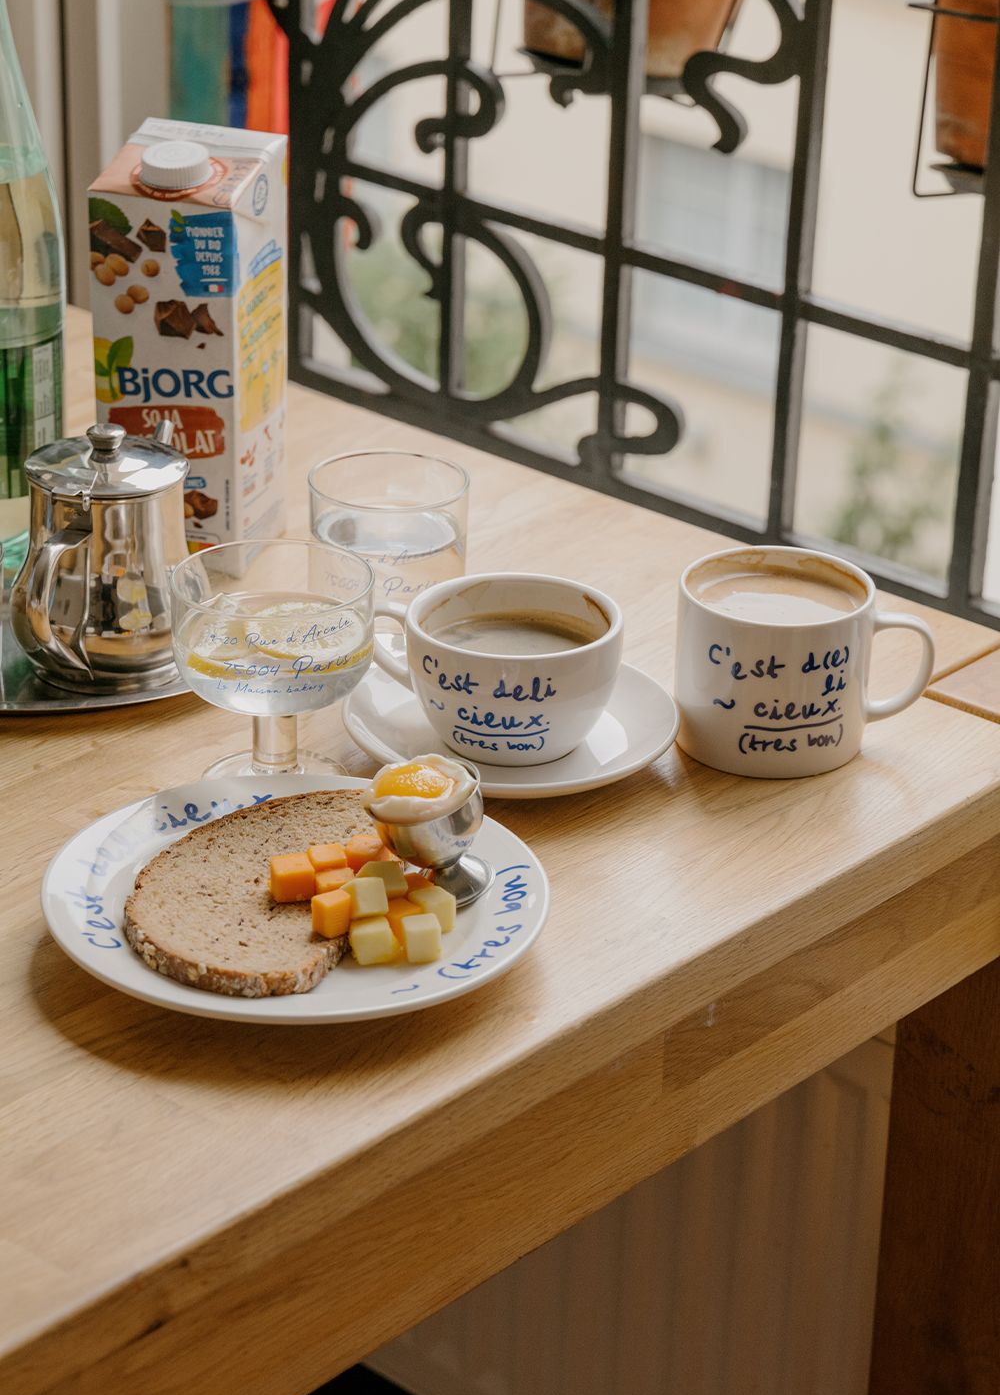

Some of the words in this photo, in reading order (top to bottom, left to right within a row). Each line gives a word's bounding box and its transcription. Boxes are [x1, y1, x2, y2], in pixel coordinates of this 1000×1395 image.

[245, 632, 278, 652] Rue
[223, 661, 281, 677] 75004
[292, 654, 351, 679] Paris
[709, 644, 786, 680] C'est
[801, 646, 850, 674] d(e)
[423, 655, 479, 695] C'est
[493, 676, 557, 702] deli
[452, 730, 499, 751] (tres
[506, 736, 545, 751] bon)
[738, 733, 798, 754] (tres
[807, 723, 844, 747] bon)
